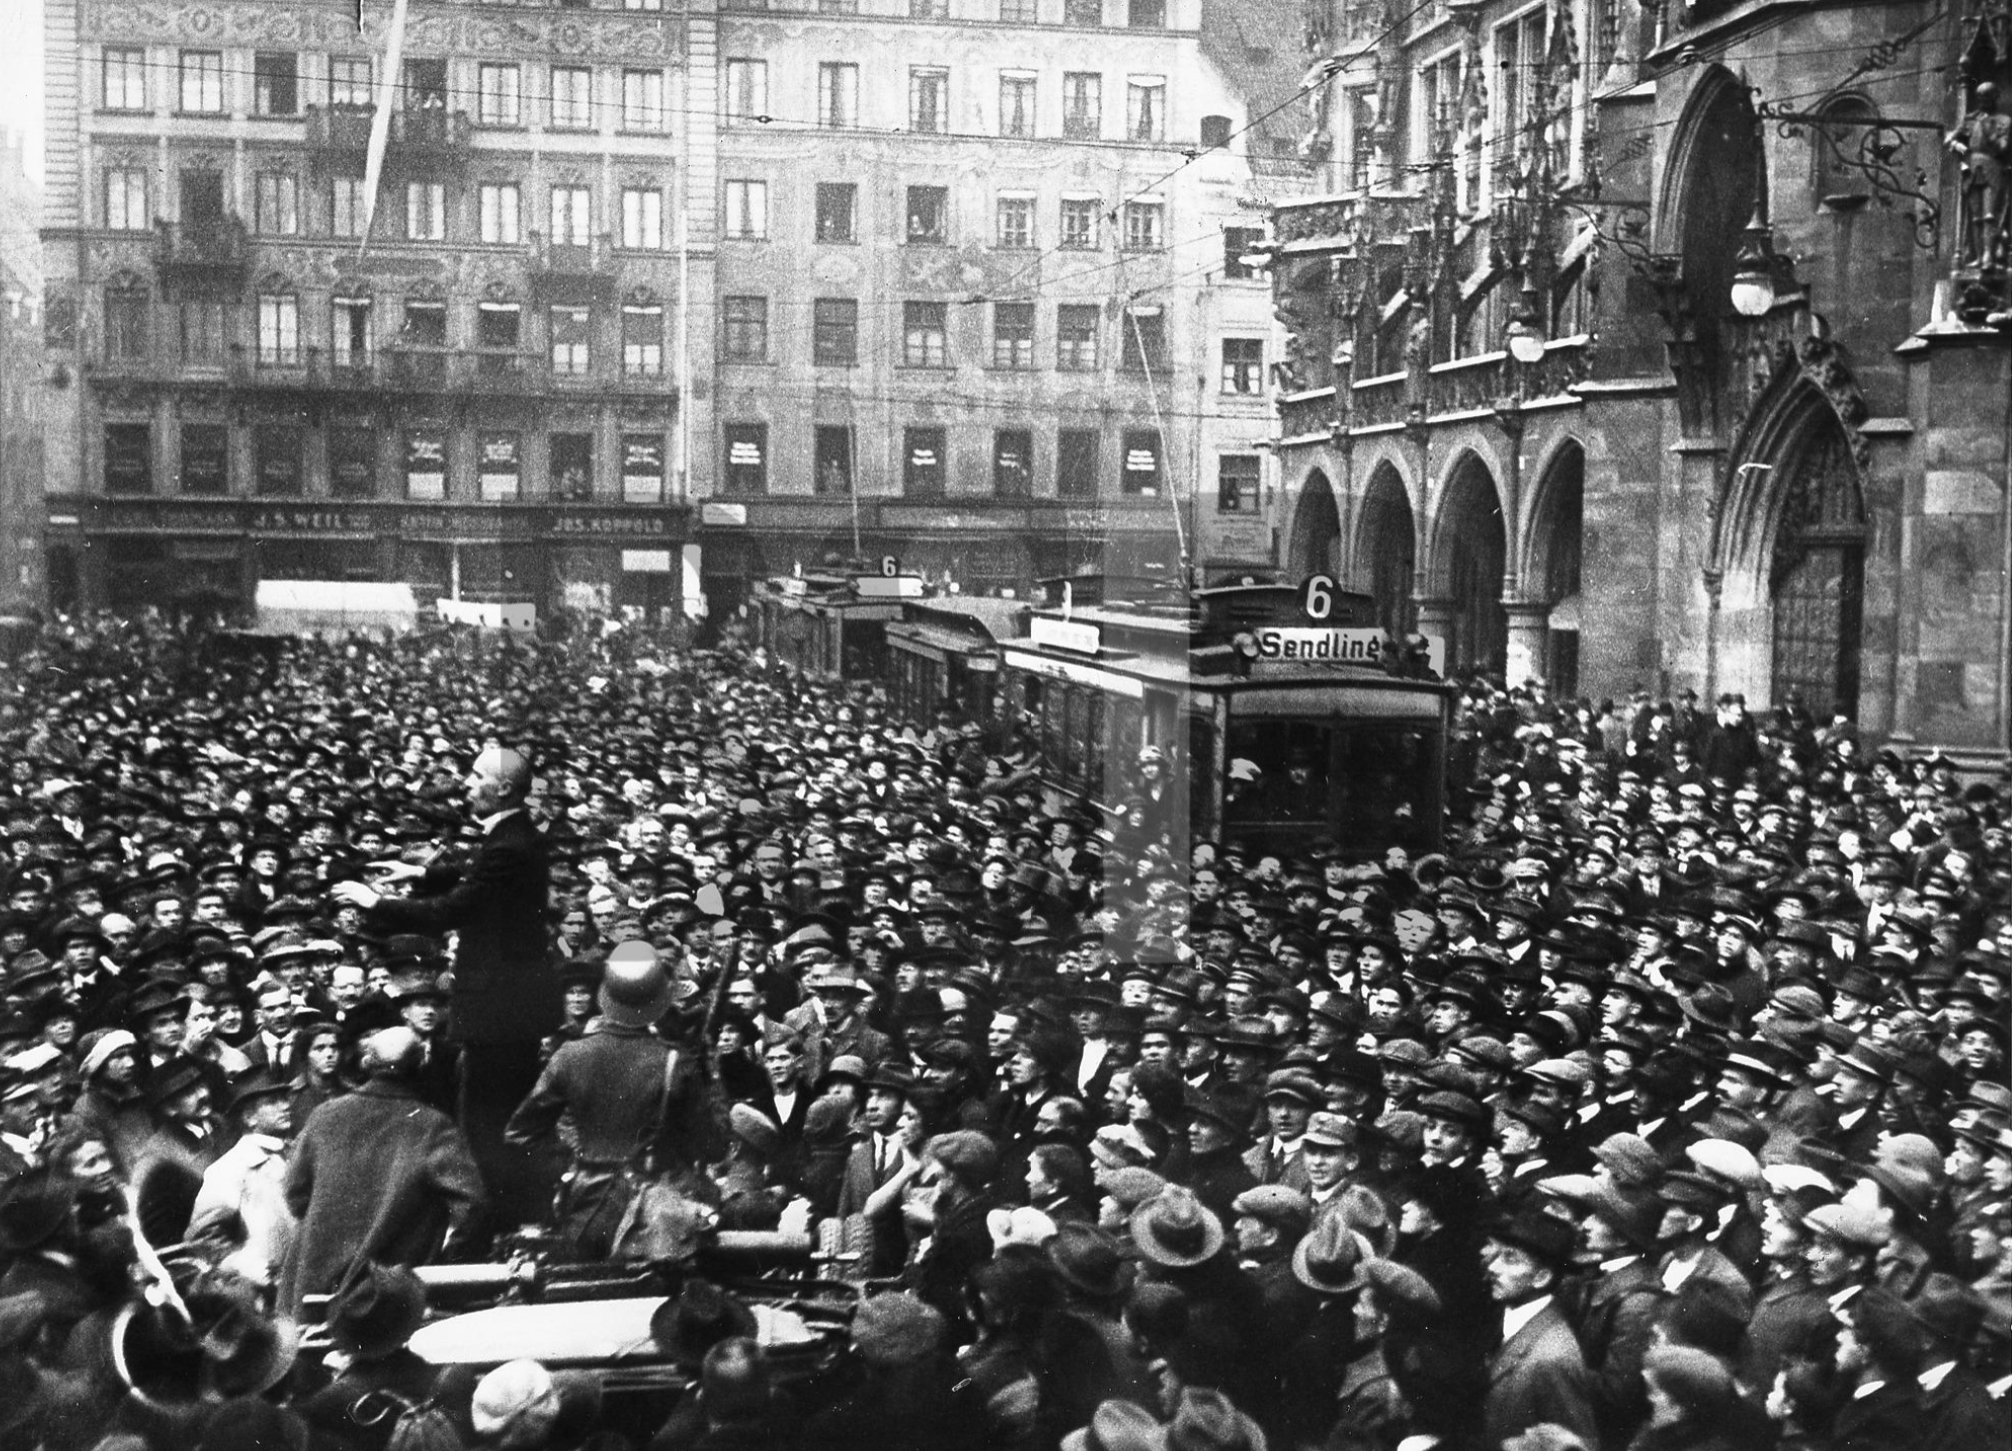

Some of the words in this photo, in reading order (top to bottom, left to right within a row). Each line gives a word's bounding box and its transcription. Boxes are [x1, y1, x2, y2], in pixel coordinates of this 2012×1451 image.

[882, 555, 896, 577] 6
[1306, 575, 1333, 619] 6
[1260, 631, 1380, 661] Sendling
